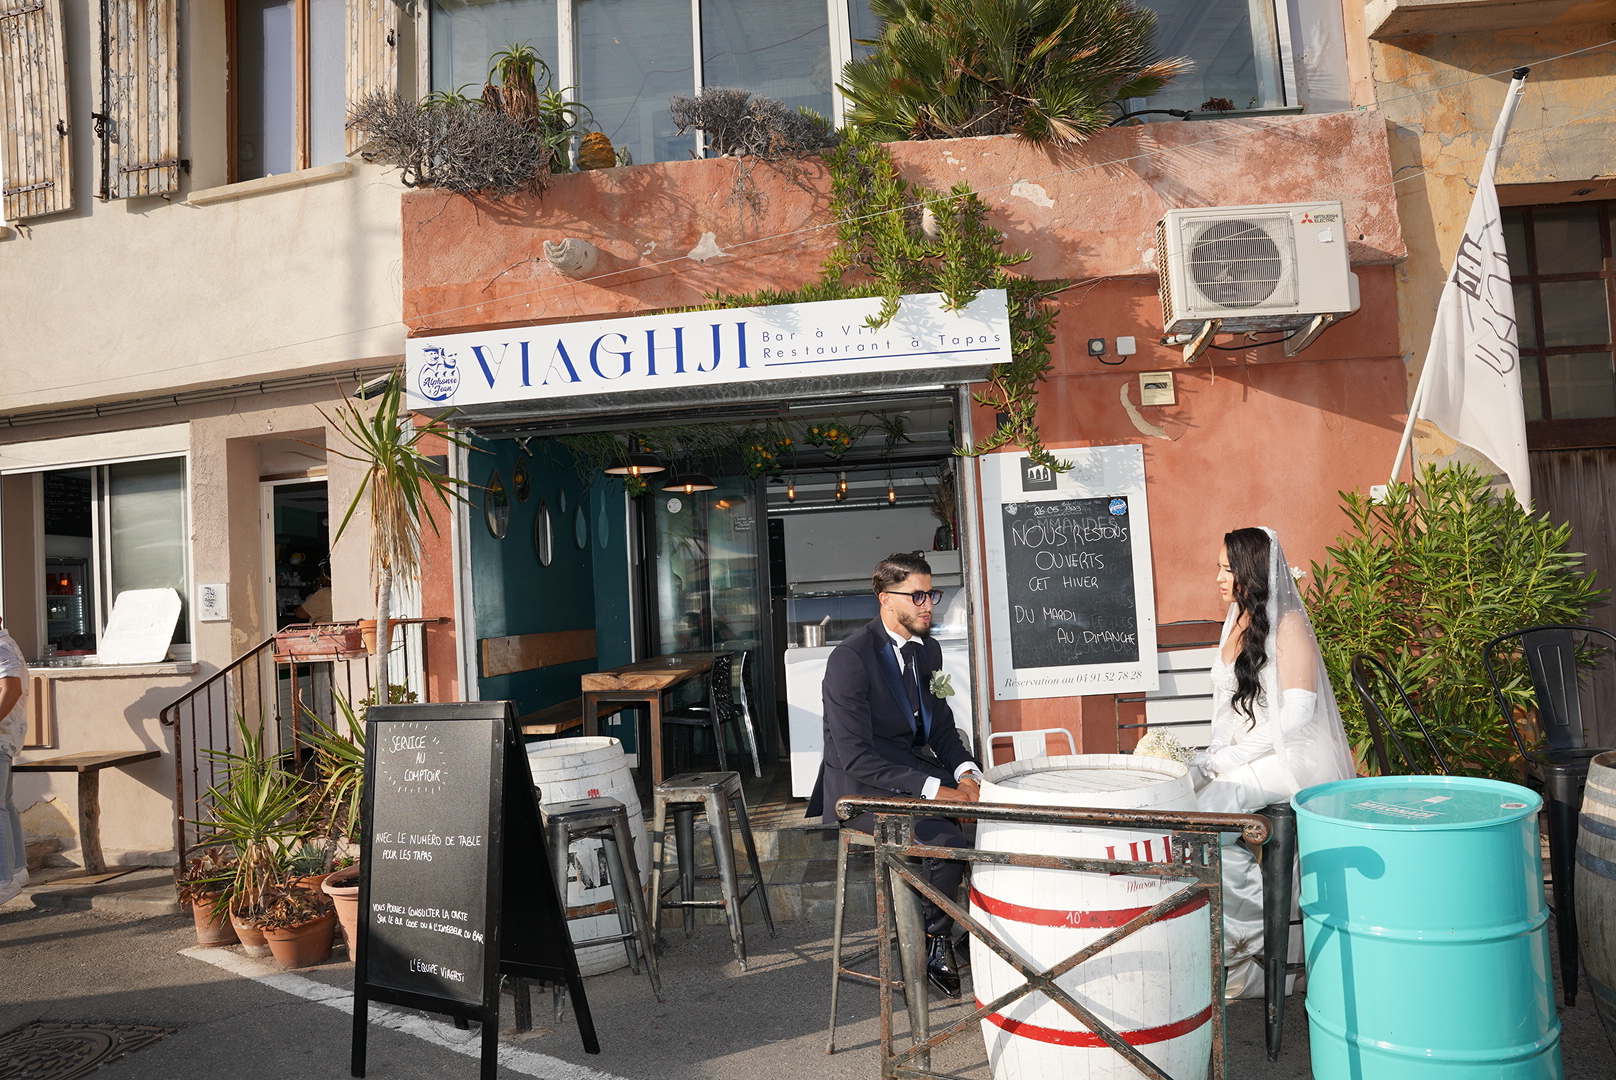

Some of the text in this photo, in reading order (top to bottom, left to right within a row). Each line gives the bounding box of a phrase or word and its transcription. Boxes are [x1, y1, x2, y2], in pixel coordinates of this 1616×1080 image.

[762, 331, 795, 343] Bar
[815, 327, 823, 338] à
[763, 333, 1001, 359] Restaurant à Tapas
[471, 321, 750, 390] VIAGHJI
[1012, 525, 1128, 548] NOUS RESTONS
[1035, 551, 1105, 570] OUVERTS
[1029, 576, 1099, 591] CET HIVER
[1014, 605, 1035, 623] DU
[1043, 607, 1077, 621] MARDI
[1057, 628, 1136, 645] AU DIMANCHE
[1004, 675, 1059, 688] Réservation
[1090, 673, 1101, 682] 91
[1104, 672, 1115, 681] 52
[1118, 671, 1129, 680] 78
[1131, 670, 1143, 679] 28
[389, 735, 426, 753] SERVICE
[415, 752, 426, 764] AU
[375, 830, 482, 846] AVEC LE NUMÉRO DE TABLE
[382, 850, 433, 862] POUR LES TAPAS
[1126, 880, 1156, 893] Maison
[372, 903, 386, 912] VOUS
[407, 907, 441, 919] CONSULTER
[442, 909, 450, 920] LA
[451, 910, 469, 921] CARTE
[376, 913, 387, 924] SUR
[388, 915, 394, 925] LE
[405, 918, 419, 928] CODE
[472, 930, 485, 945] BAR
